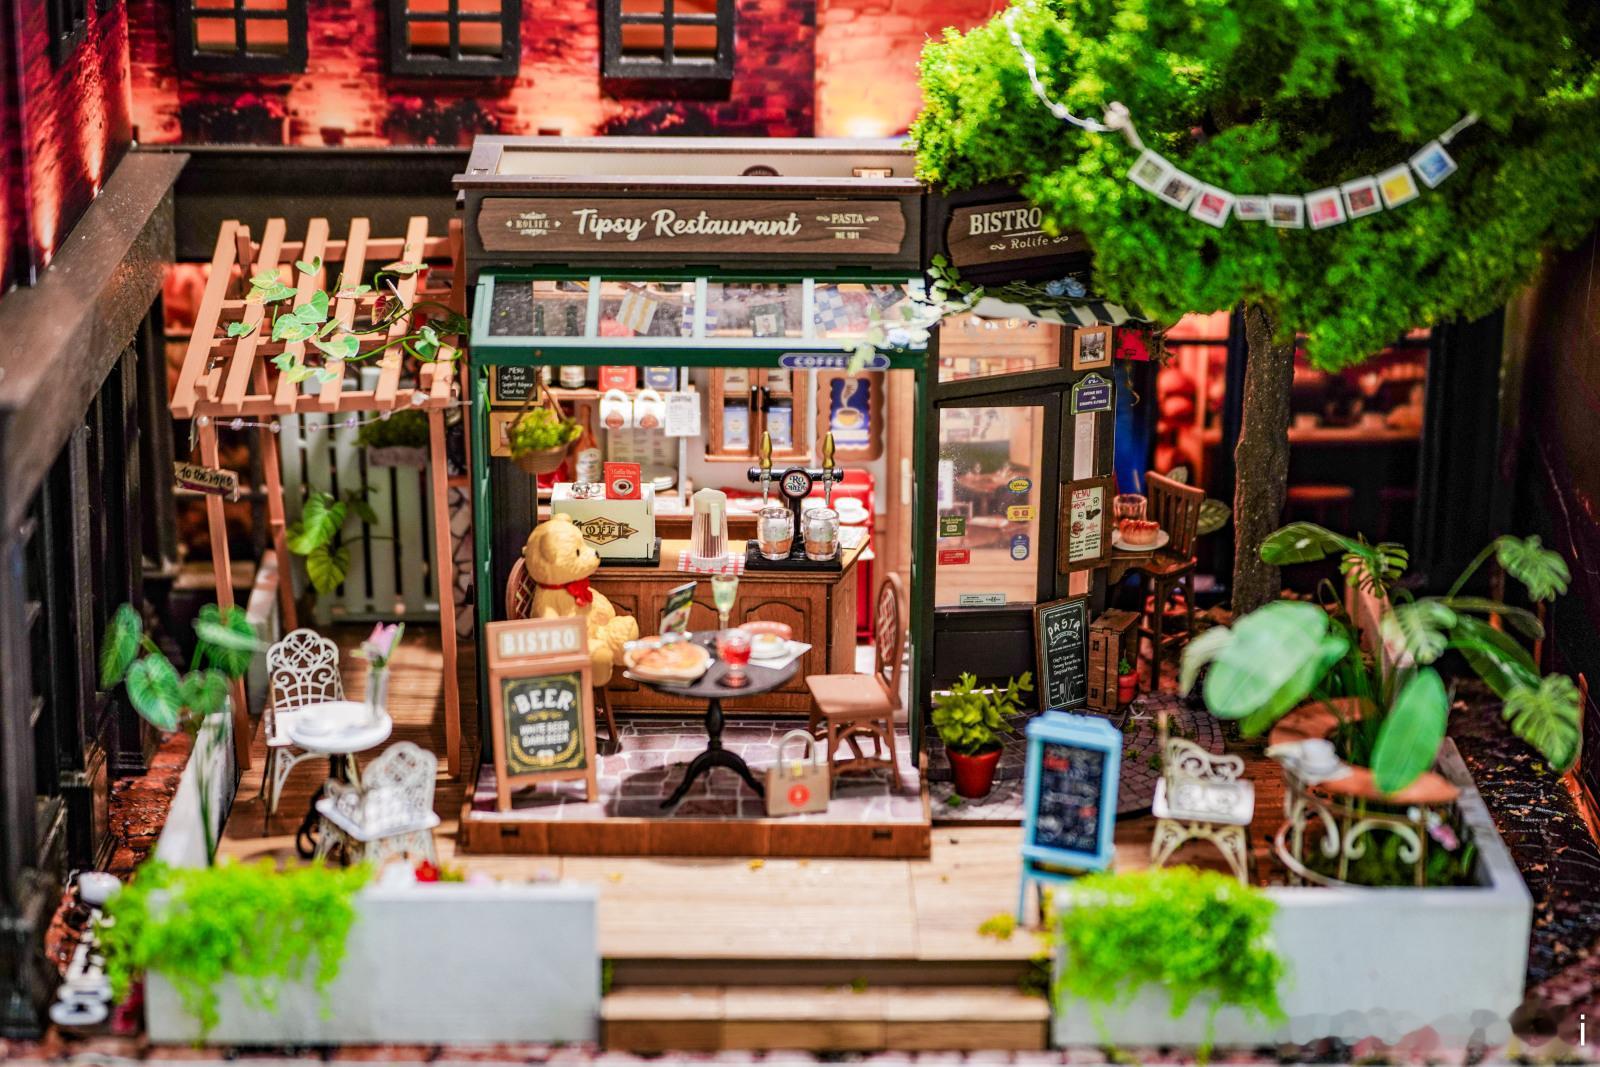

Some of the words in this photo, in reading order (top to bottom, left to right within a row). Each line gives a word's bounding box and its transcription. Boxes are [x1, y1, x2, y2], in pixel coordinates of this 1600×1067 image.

[515, 220, 550, 229] ROLIFE
[572, 208, 647, 241] Tipsy
[651, 209, 801, 237] Restaurant
[831, 213, 864, 224] PASTA
[969, 207, 1042, 235] BISTRO
[1010, 235, 1049, 249] Rolife
[1047, 619, 1081, 638] PASTA
[503, 627, 576, 656] BISTRO
[514, 688, 573, 714] BEER
